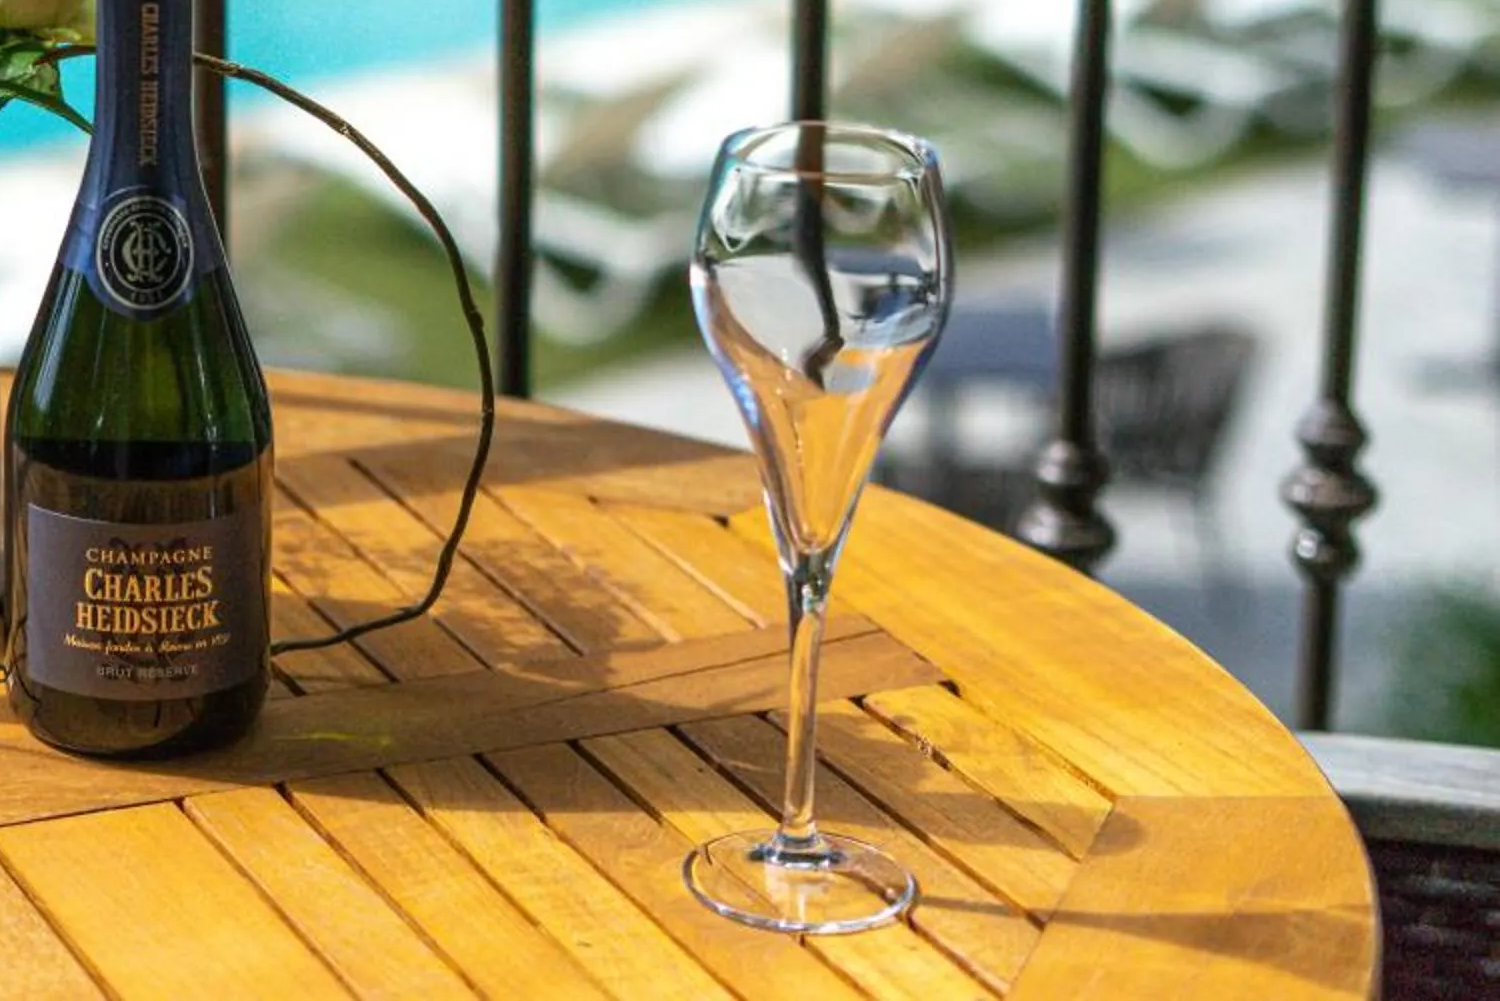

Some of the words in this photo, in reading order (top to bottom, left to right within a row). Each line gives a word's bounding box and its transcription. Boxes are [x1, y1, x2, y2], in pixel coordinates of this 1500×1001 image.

[85, 546, 213, 565] CHAMPAGNE
[84, 566, 213, 601] CHARLES
[75, 599, 221, 634] HEIDSIECK
